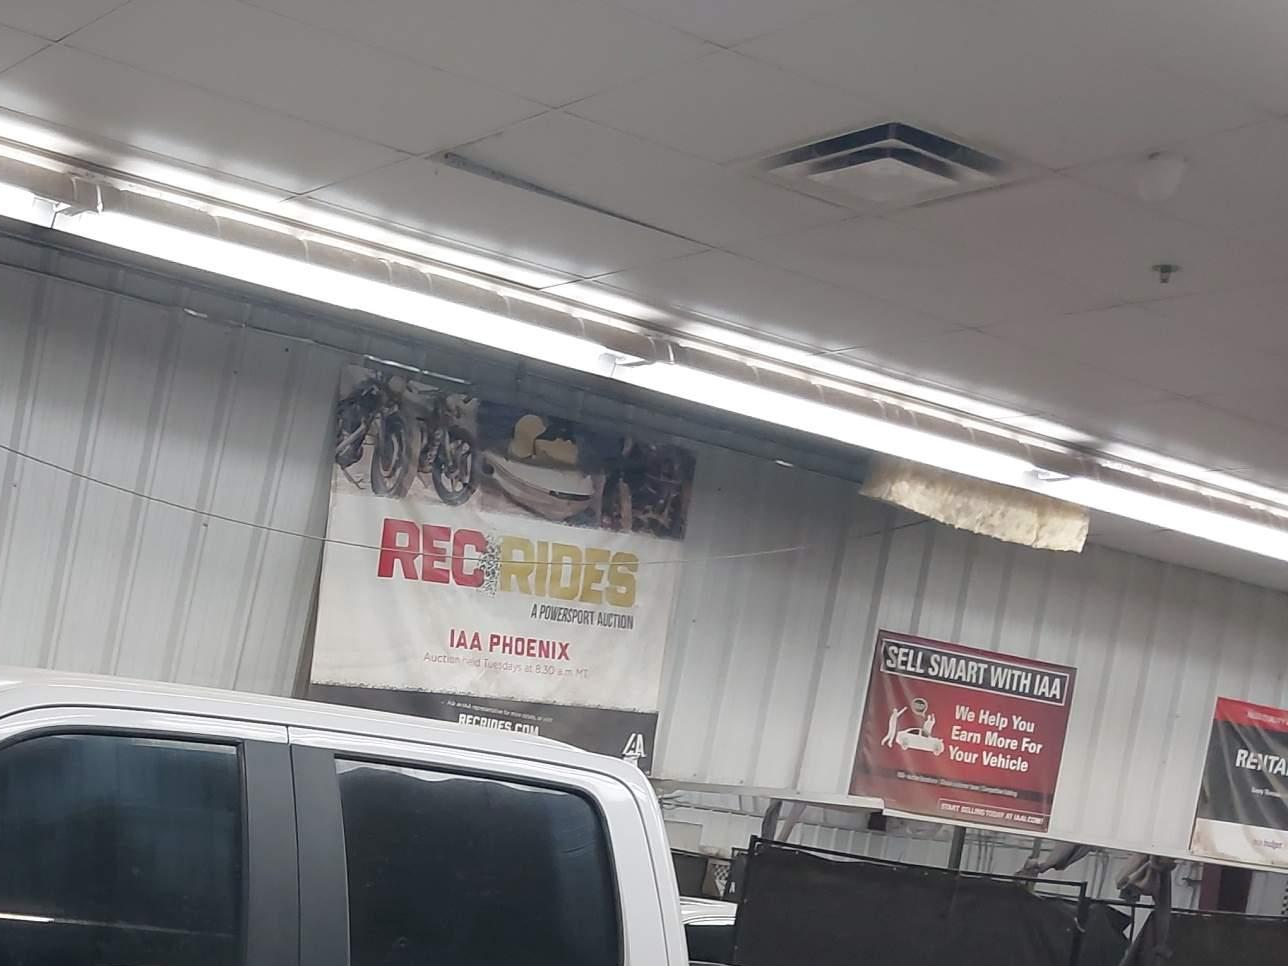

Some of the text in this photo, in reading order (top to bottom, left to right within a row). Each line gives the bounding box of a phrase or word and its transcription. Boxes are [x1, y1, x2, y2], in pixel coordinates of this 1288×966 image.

[377, 518, 640, 608] REC RIDES
[530, 604, 634, 630] A POWERSPORT AUCTION
[449, 629, 570, 661] IAA PHOENIX
[423, 652, 460, 665] Auction
[482, 659, 522, 673] Tuesdays
[524, 664, 533, 673] at
[886, 645, 1061, 699] SELL SMART WITH IAA
[955, 704, 1035, 733] We Help You
[951, 725, 1043, 754] Earn More For
[948, 745, 1029, 772] Your Vehicle
[1235, 749, 1288, 777] RENTA
